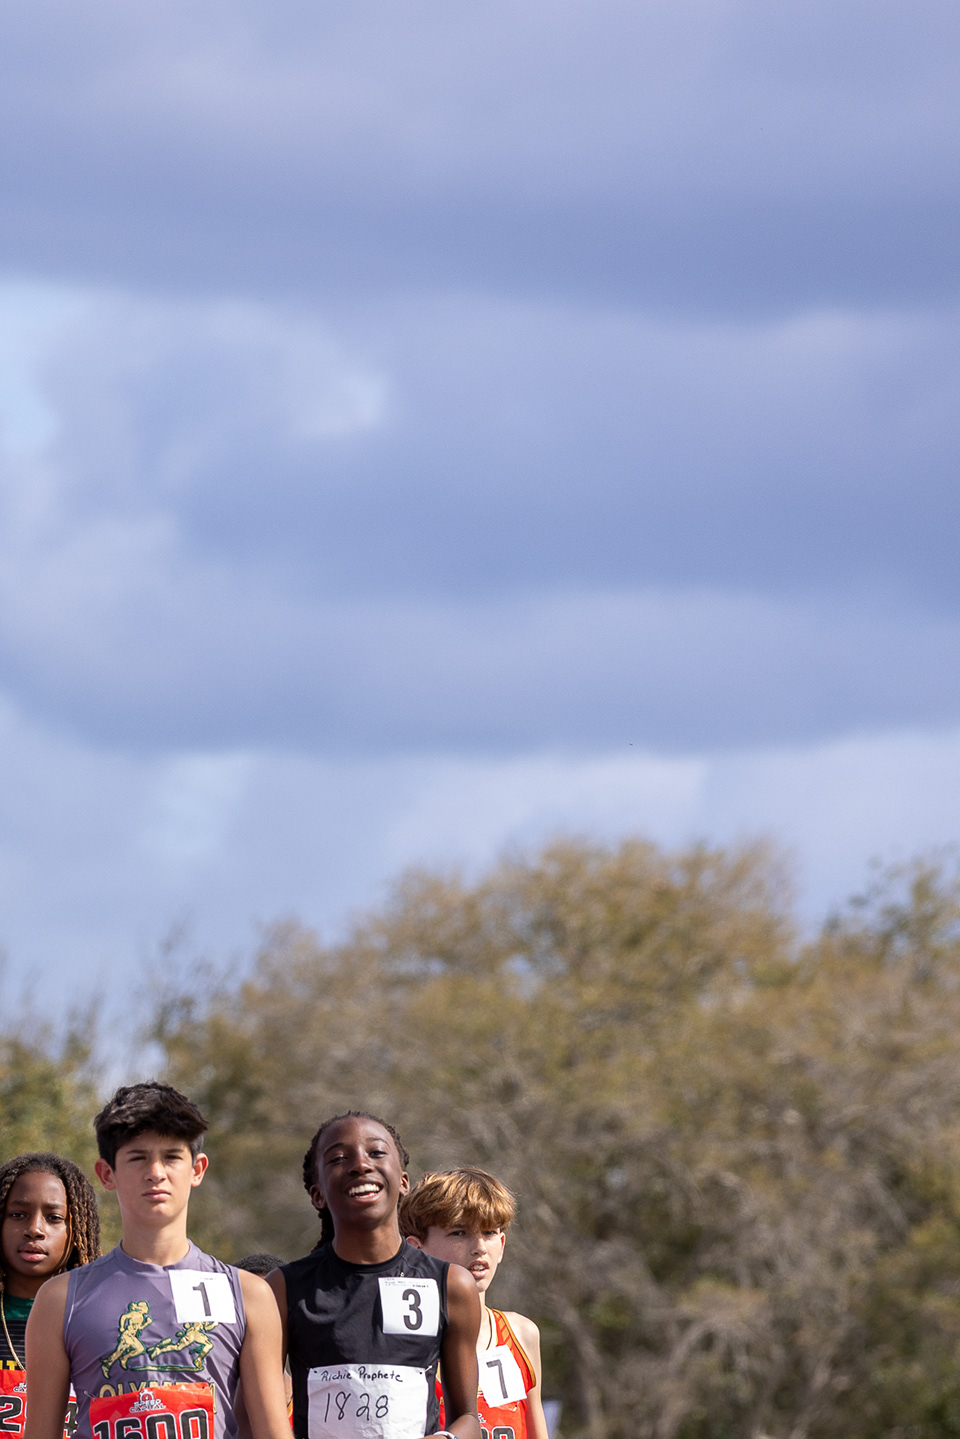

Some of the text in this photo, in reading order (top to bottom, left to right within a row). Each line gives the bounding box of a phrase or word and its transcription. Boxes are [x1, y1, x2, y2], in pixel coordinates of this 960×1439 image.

[192, 1281, 212, 1317] 1
[402, 1288, 423, 1331] 3
[486, 1359, 509, 1399] 7
[324, 1391, 389, 1423] 1828
